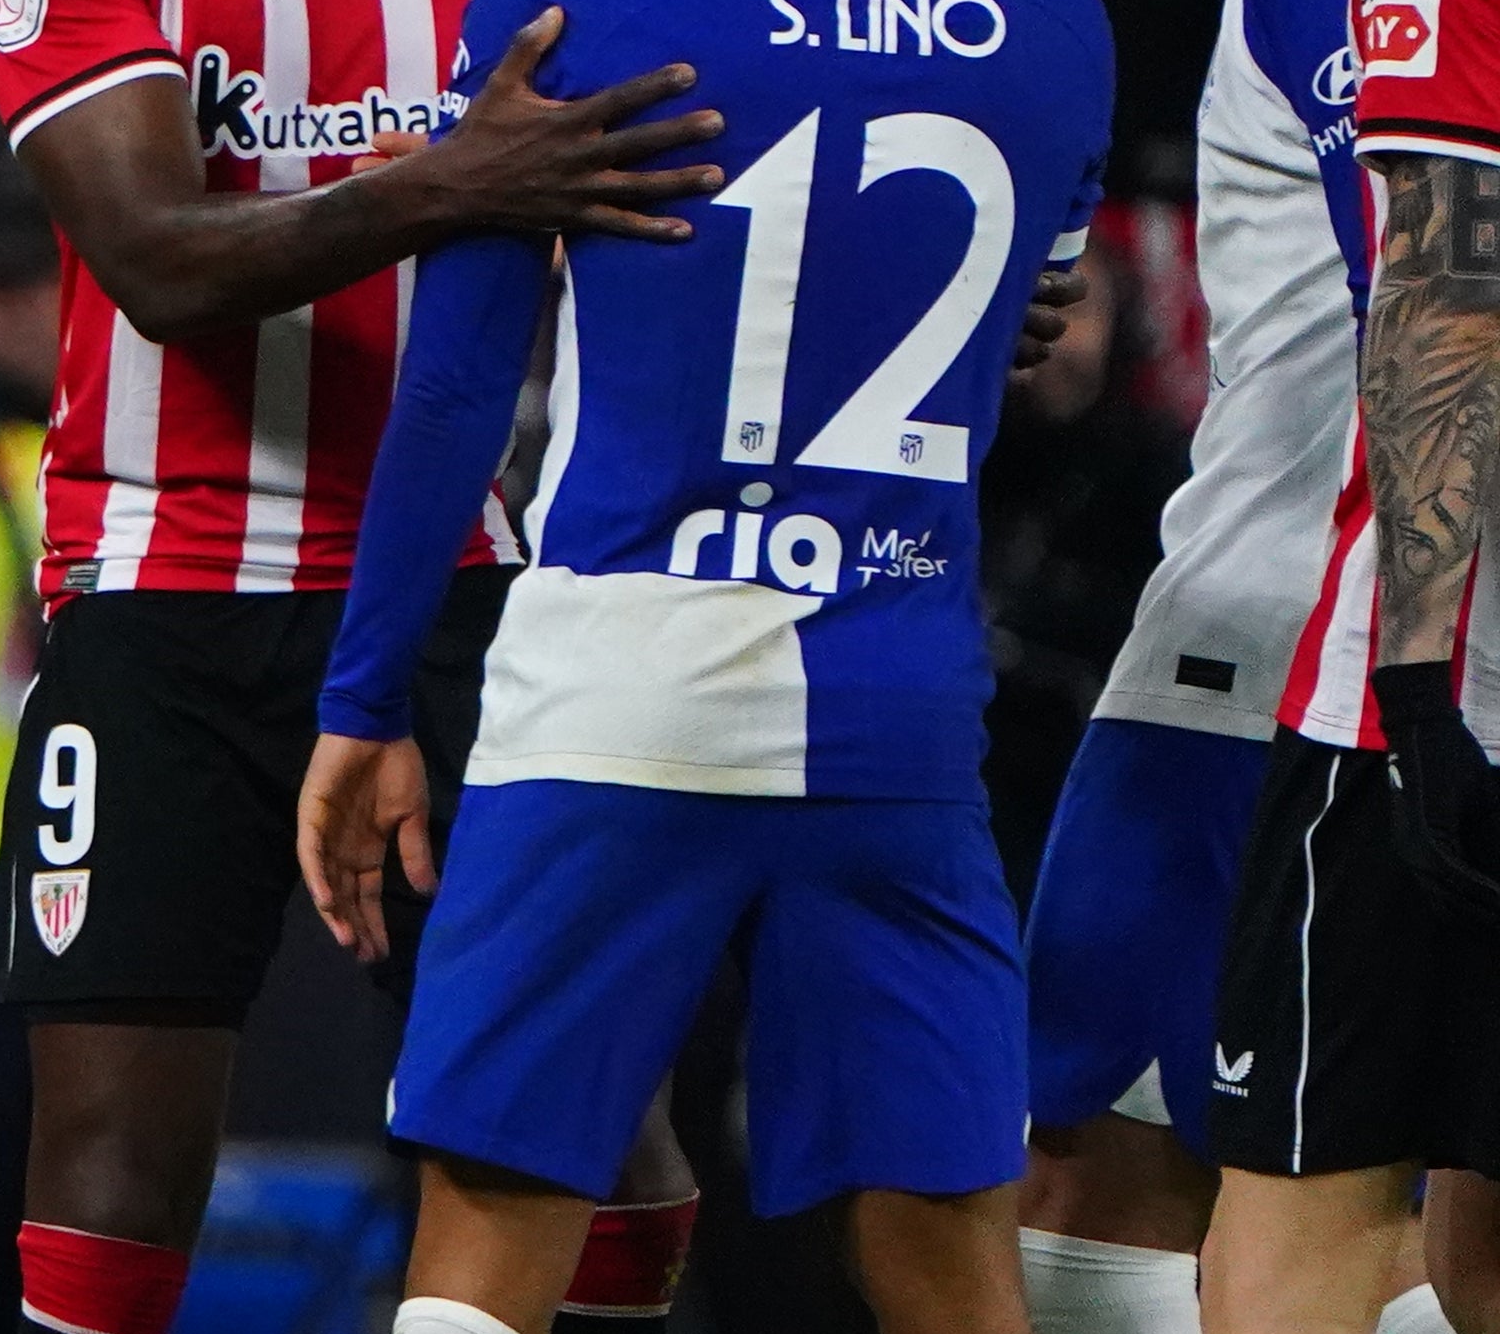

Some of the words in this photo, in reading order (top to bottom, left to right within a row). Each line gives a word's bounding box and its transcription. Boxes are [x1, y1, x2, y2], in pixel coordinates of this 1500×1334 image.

[197, 53, 432, 151] Kutxaba
[710, 106, 1016, 484] 12
[667, 481, 843, 593] ria
[38, 723, 98, 866] 9
